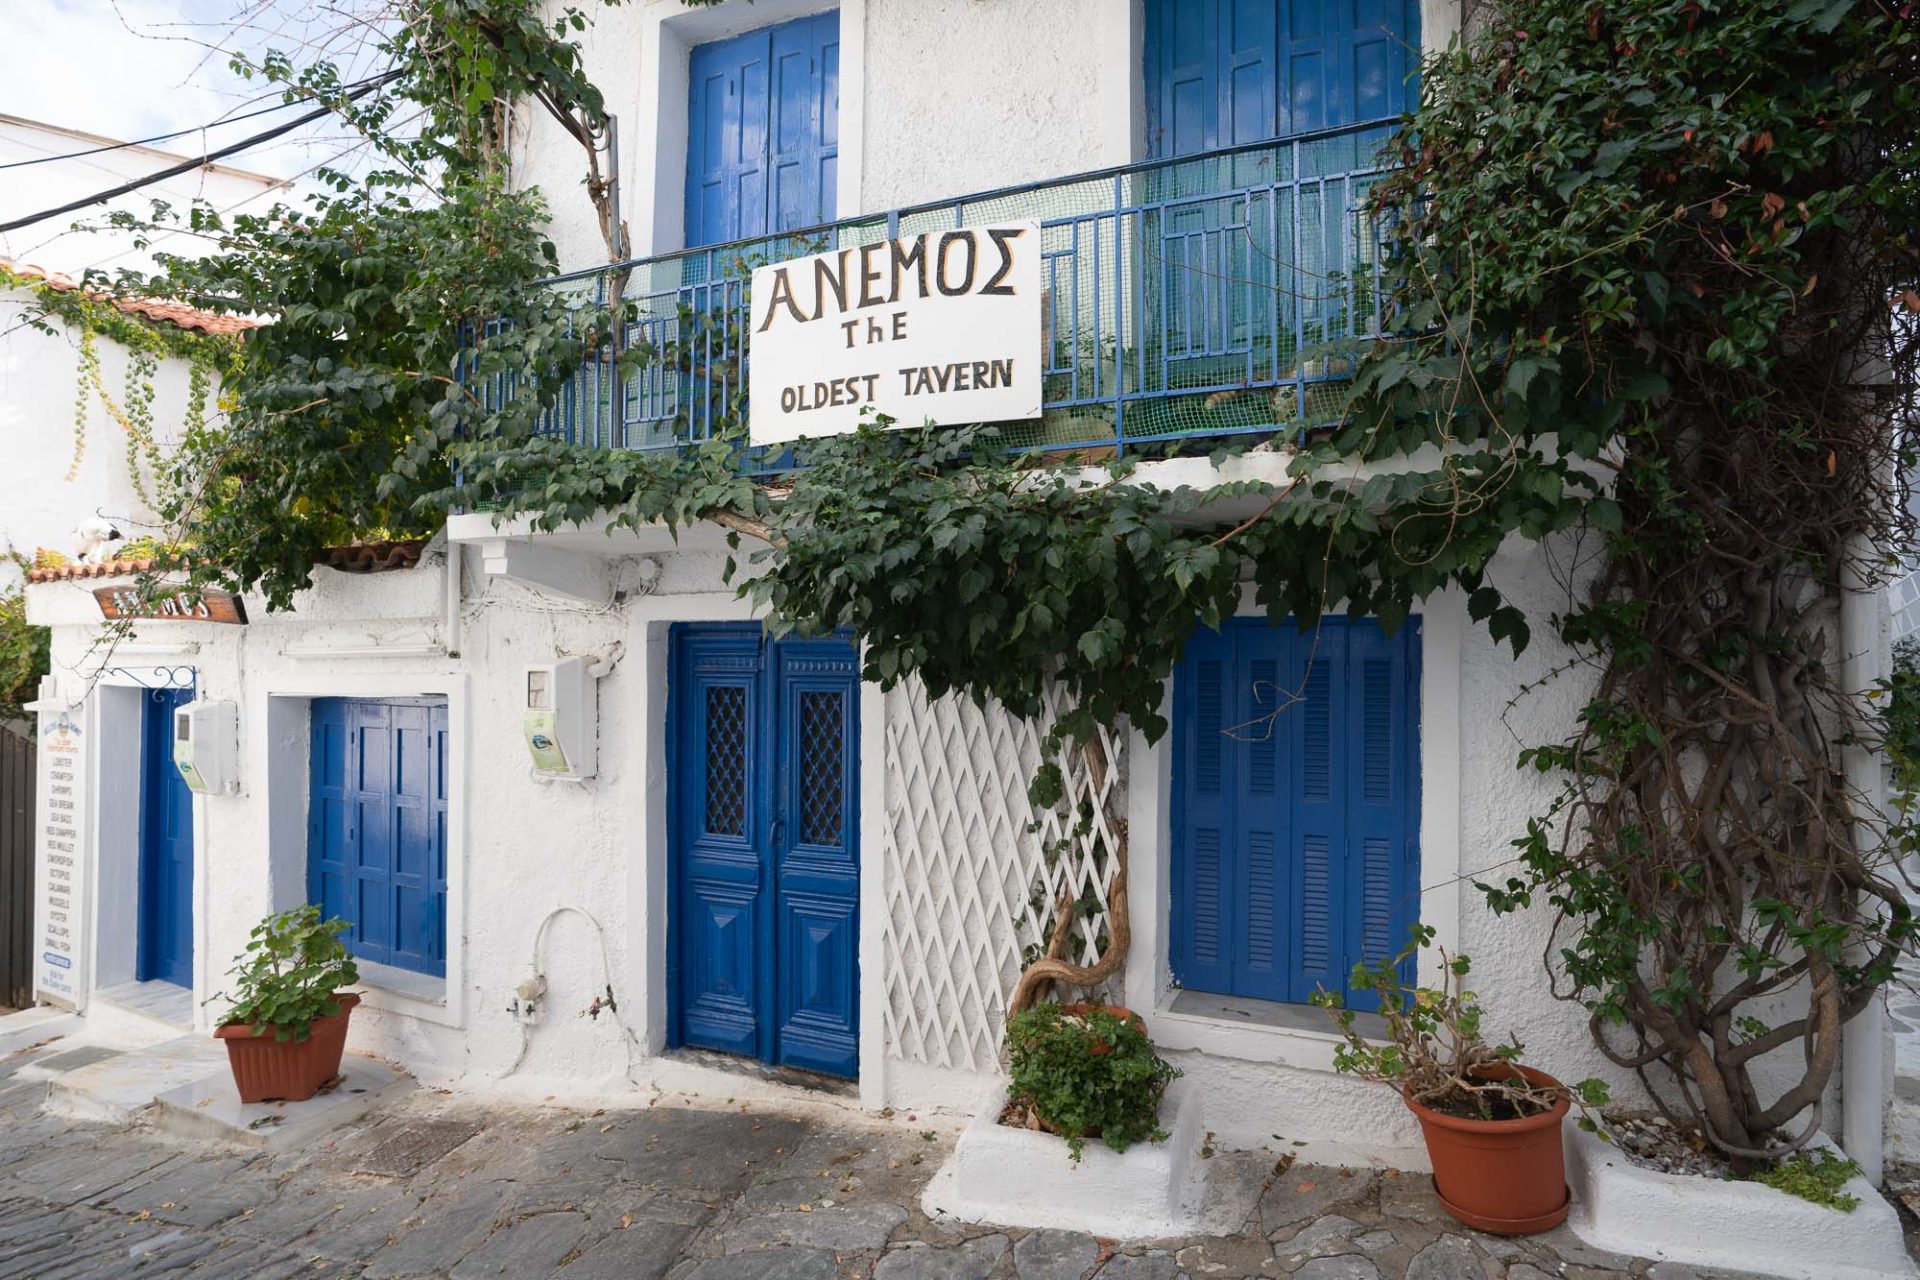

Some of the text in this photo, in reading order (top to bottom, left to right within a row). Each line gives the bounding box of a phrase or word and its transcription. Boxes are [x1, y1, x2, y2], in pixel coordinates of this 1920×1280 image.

[757, 229, 1027, 334] ΑΝΕΜΟΣ
[781, 358, 1014, 414] OLDEST TAVERN
